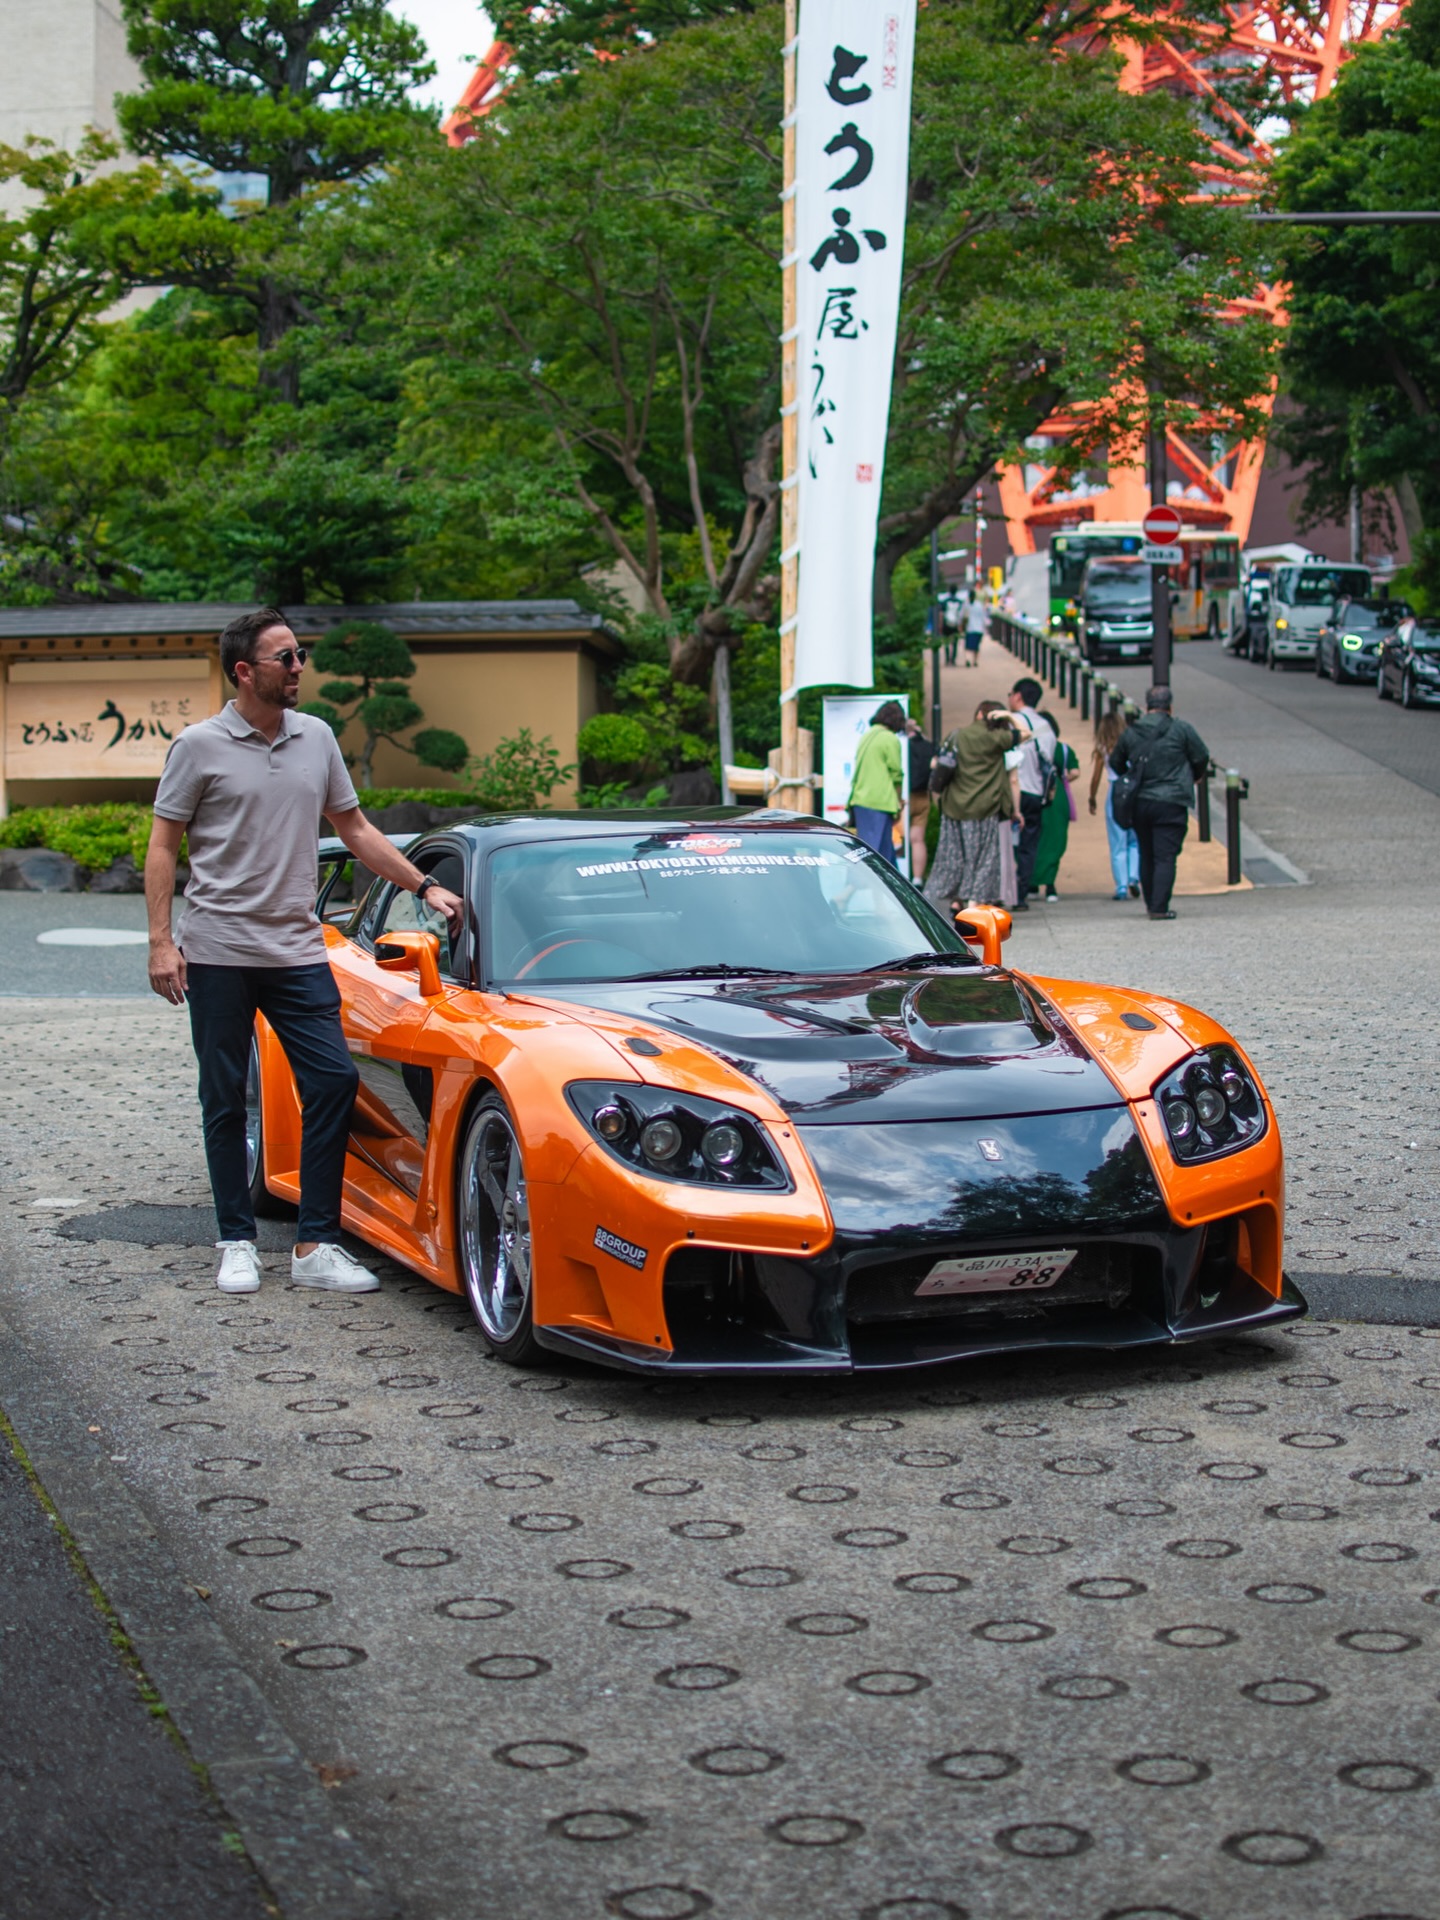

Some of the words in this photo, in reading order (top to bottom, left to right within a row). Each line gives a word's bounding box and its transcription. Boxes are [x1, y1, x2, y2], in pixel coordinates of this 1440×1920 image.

[666, 838, 743, 849] TOKYO
[576, 855, 830, 877] WWW.TOKYOEXTREMEDRIVE.COM
[596, 1228, 646, 1260] 88GROUP
